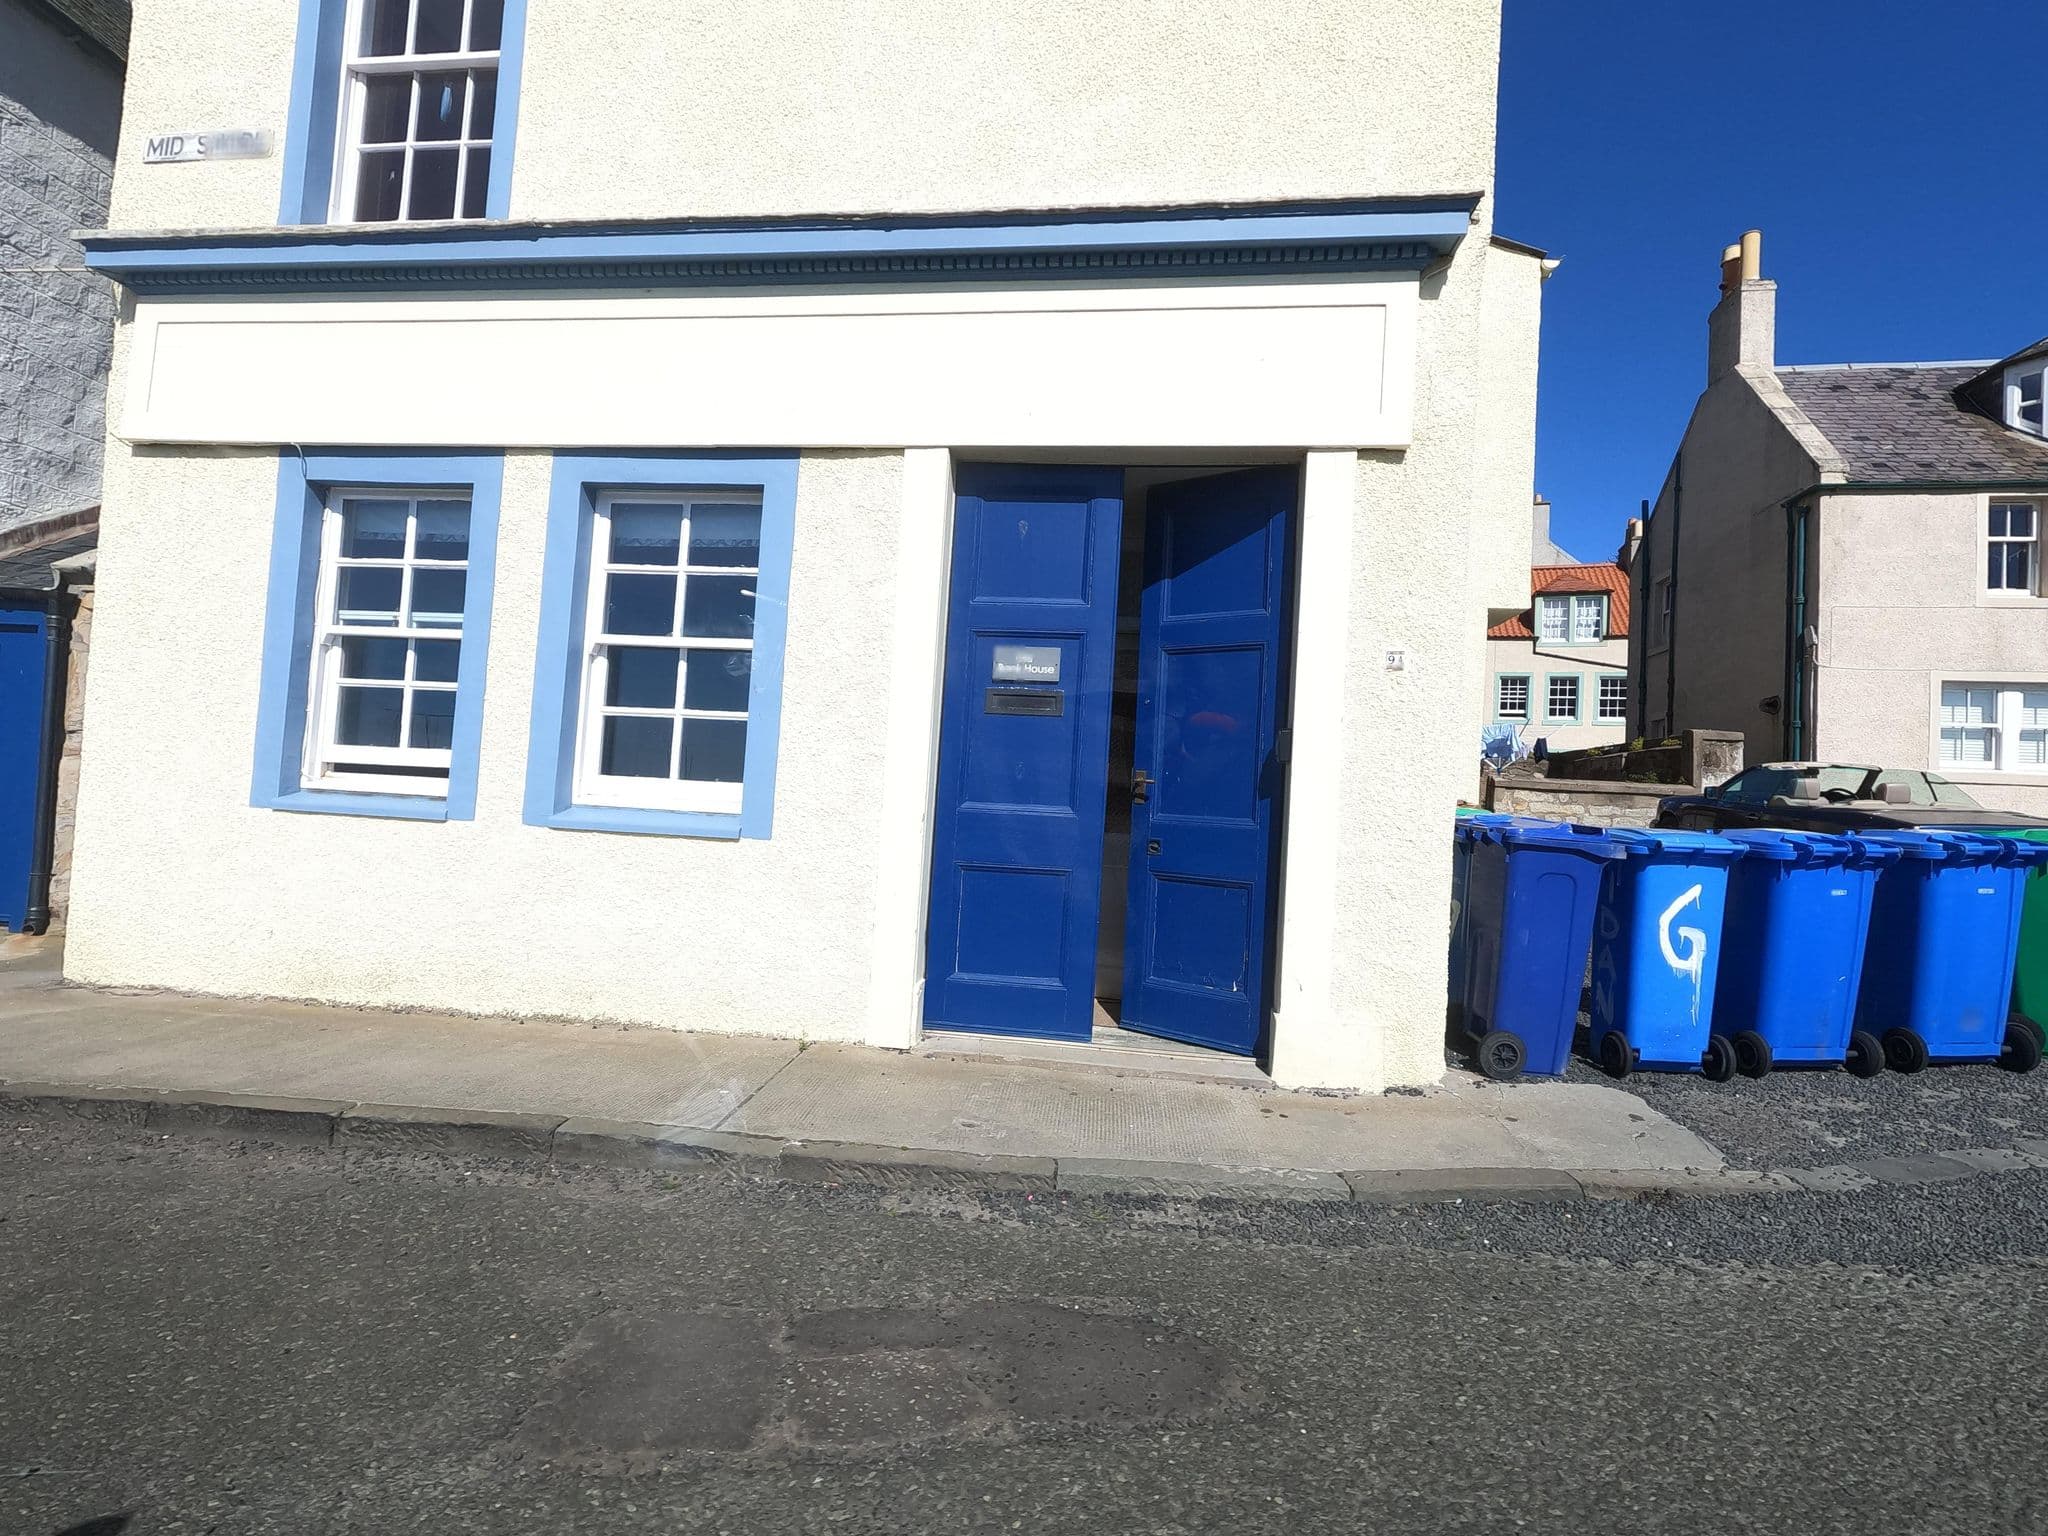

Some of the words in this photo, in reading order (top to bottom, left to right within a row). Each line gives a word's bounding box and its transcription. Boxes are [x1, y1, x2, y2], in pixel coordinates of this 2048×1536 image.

[146, 136, 184, 157] MID
[1024, 663, 1055, 674] House
[1659, 884, 1707, 985] G
